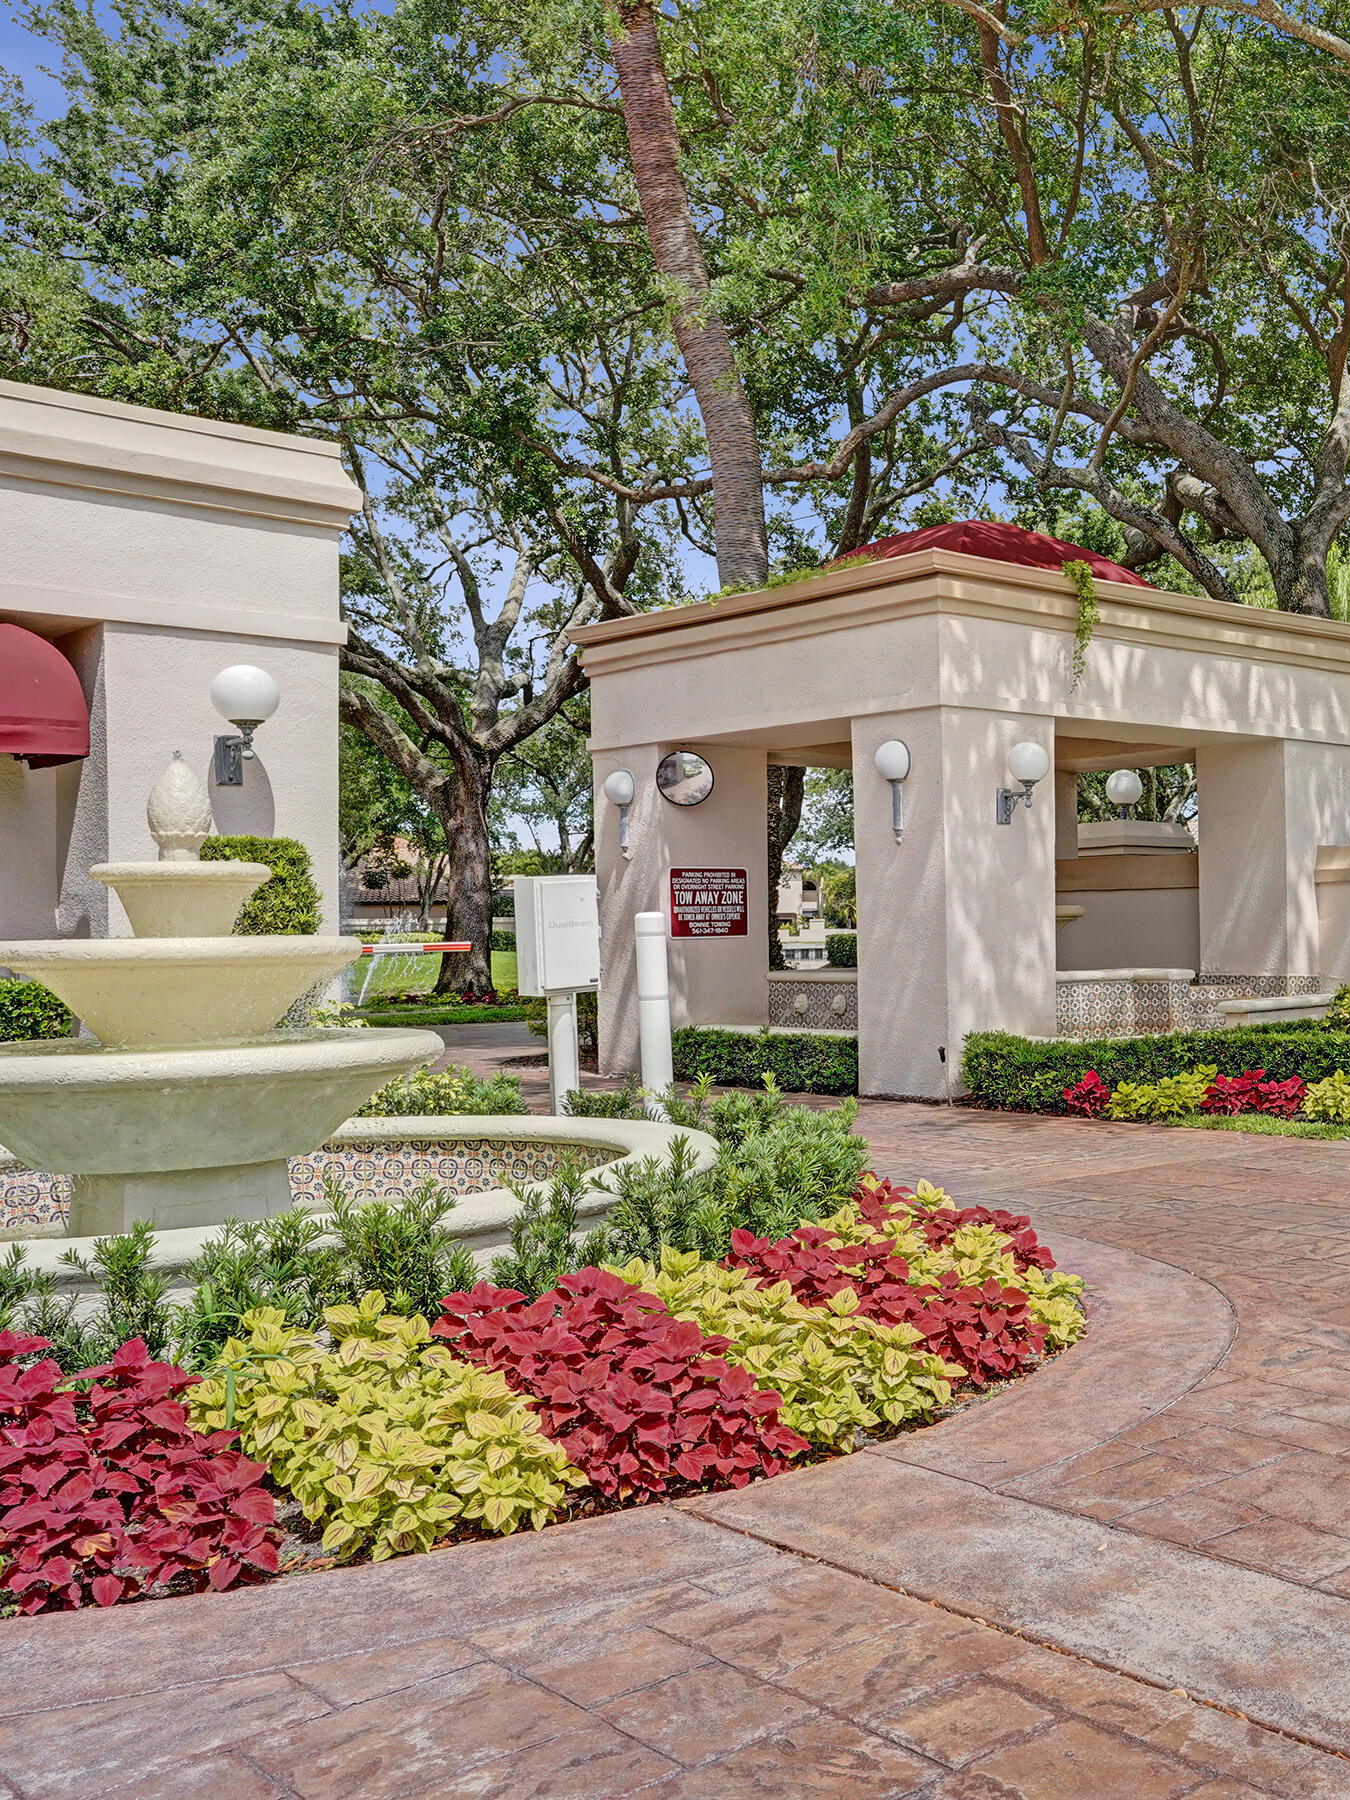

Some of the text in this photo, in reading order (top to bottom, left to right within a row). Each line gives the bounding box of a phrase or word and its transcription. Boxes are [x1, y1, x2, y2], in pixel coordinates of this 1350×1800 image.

[674, 891, 744, 904] TOW AWAY ZONE
